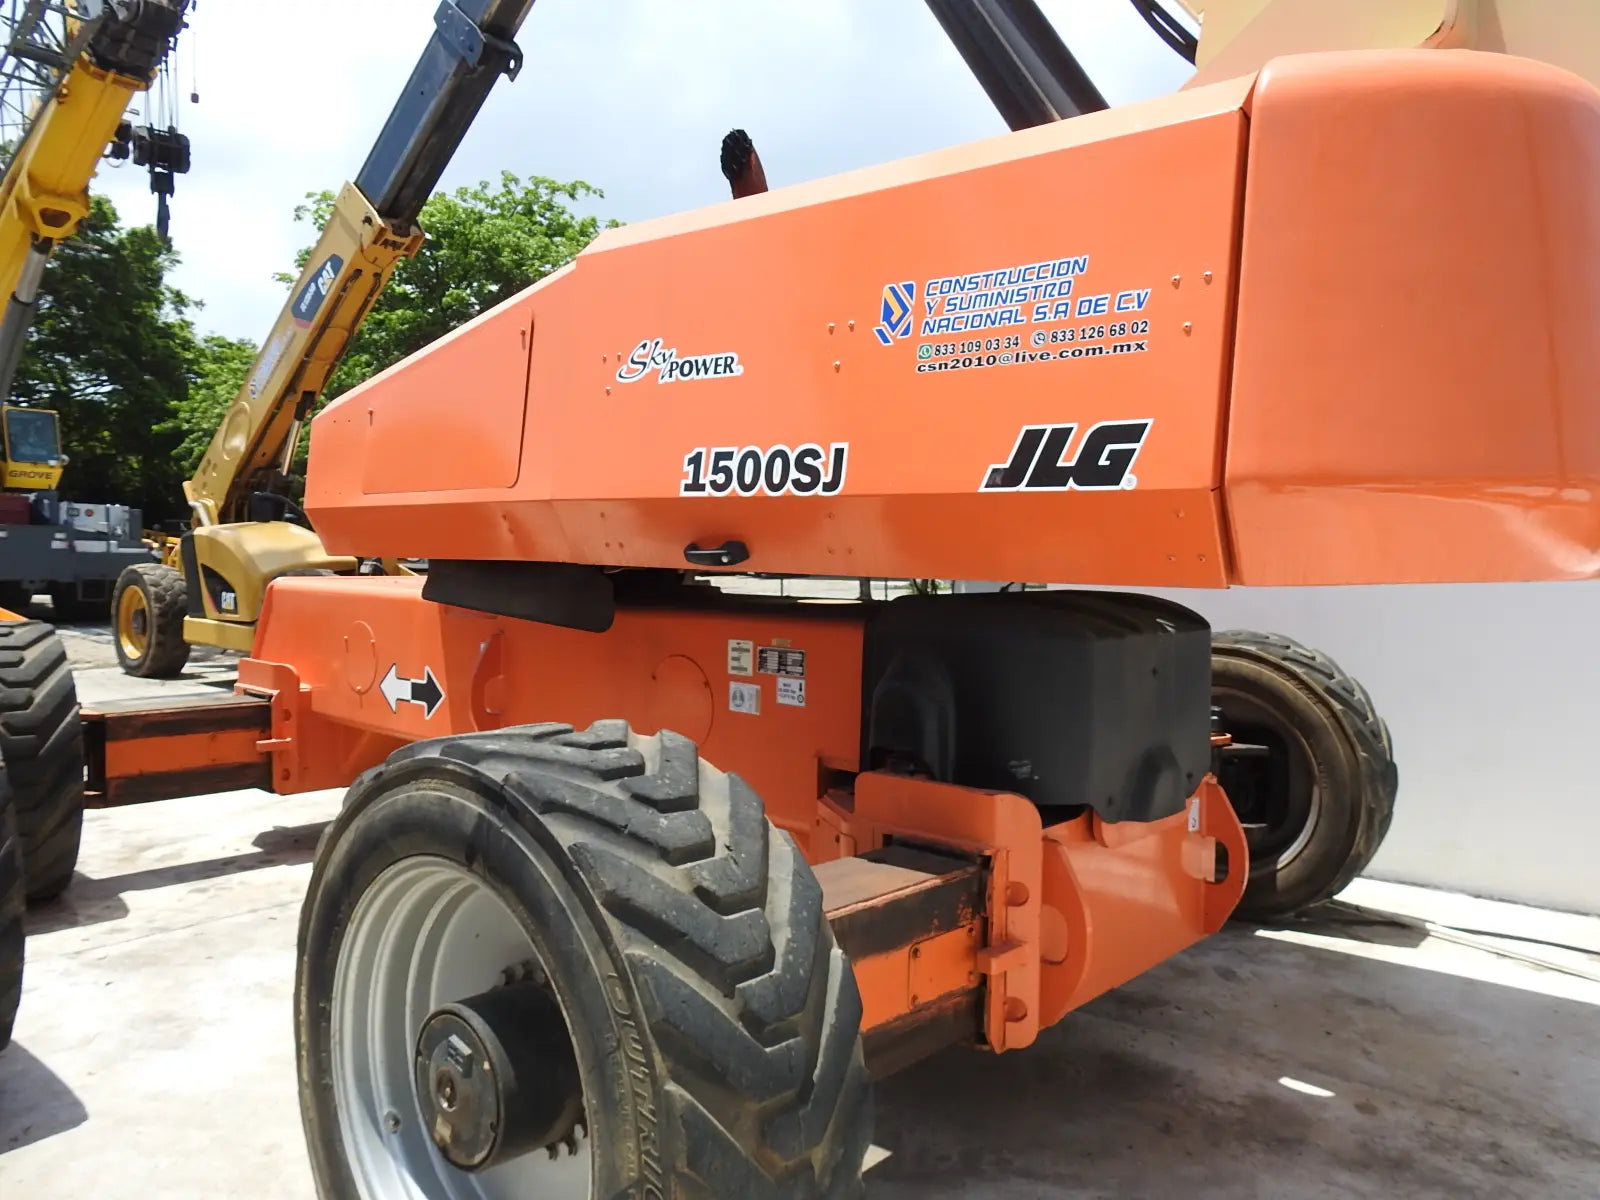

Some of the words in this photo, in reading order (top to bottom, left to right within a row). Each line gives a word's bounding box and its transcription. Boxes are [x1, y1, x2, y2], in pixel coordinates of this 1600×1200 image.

[925, 256, 1088, 297] CONSTRUCCION
[926, 299, 939, 315] Y
[945, 280, 1073, 313] SUMINISTRO
[922, 308, 1026, 335] NACIONAL
[1077, 296, 1109, 316] DE
[1050, 329, 1076, 343] 833
[1080, 325, 1105, 340] 126
[1109, 322, 1126, 337] 68
[1131, 320, 1149, 334] 02
[917, 341, 1147, 372] csn2010@live.com.mx
[934, 343, 956, 356] 833
[960, 340, 981, 354] 109
[985, 338, 1001, 351] 03
[1004, 335, 1020, 349] 34
[682, 446, 846, 494] 1500SJ
[982, 421, 1151, 490] JLG
[8, 469, 54, 480] GROVE
